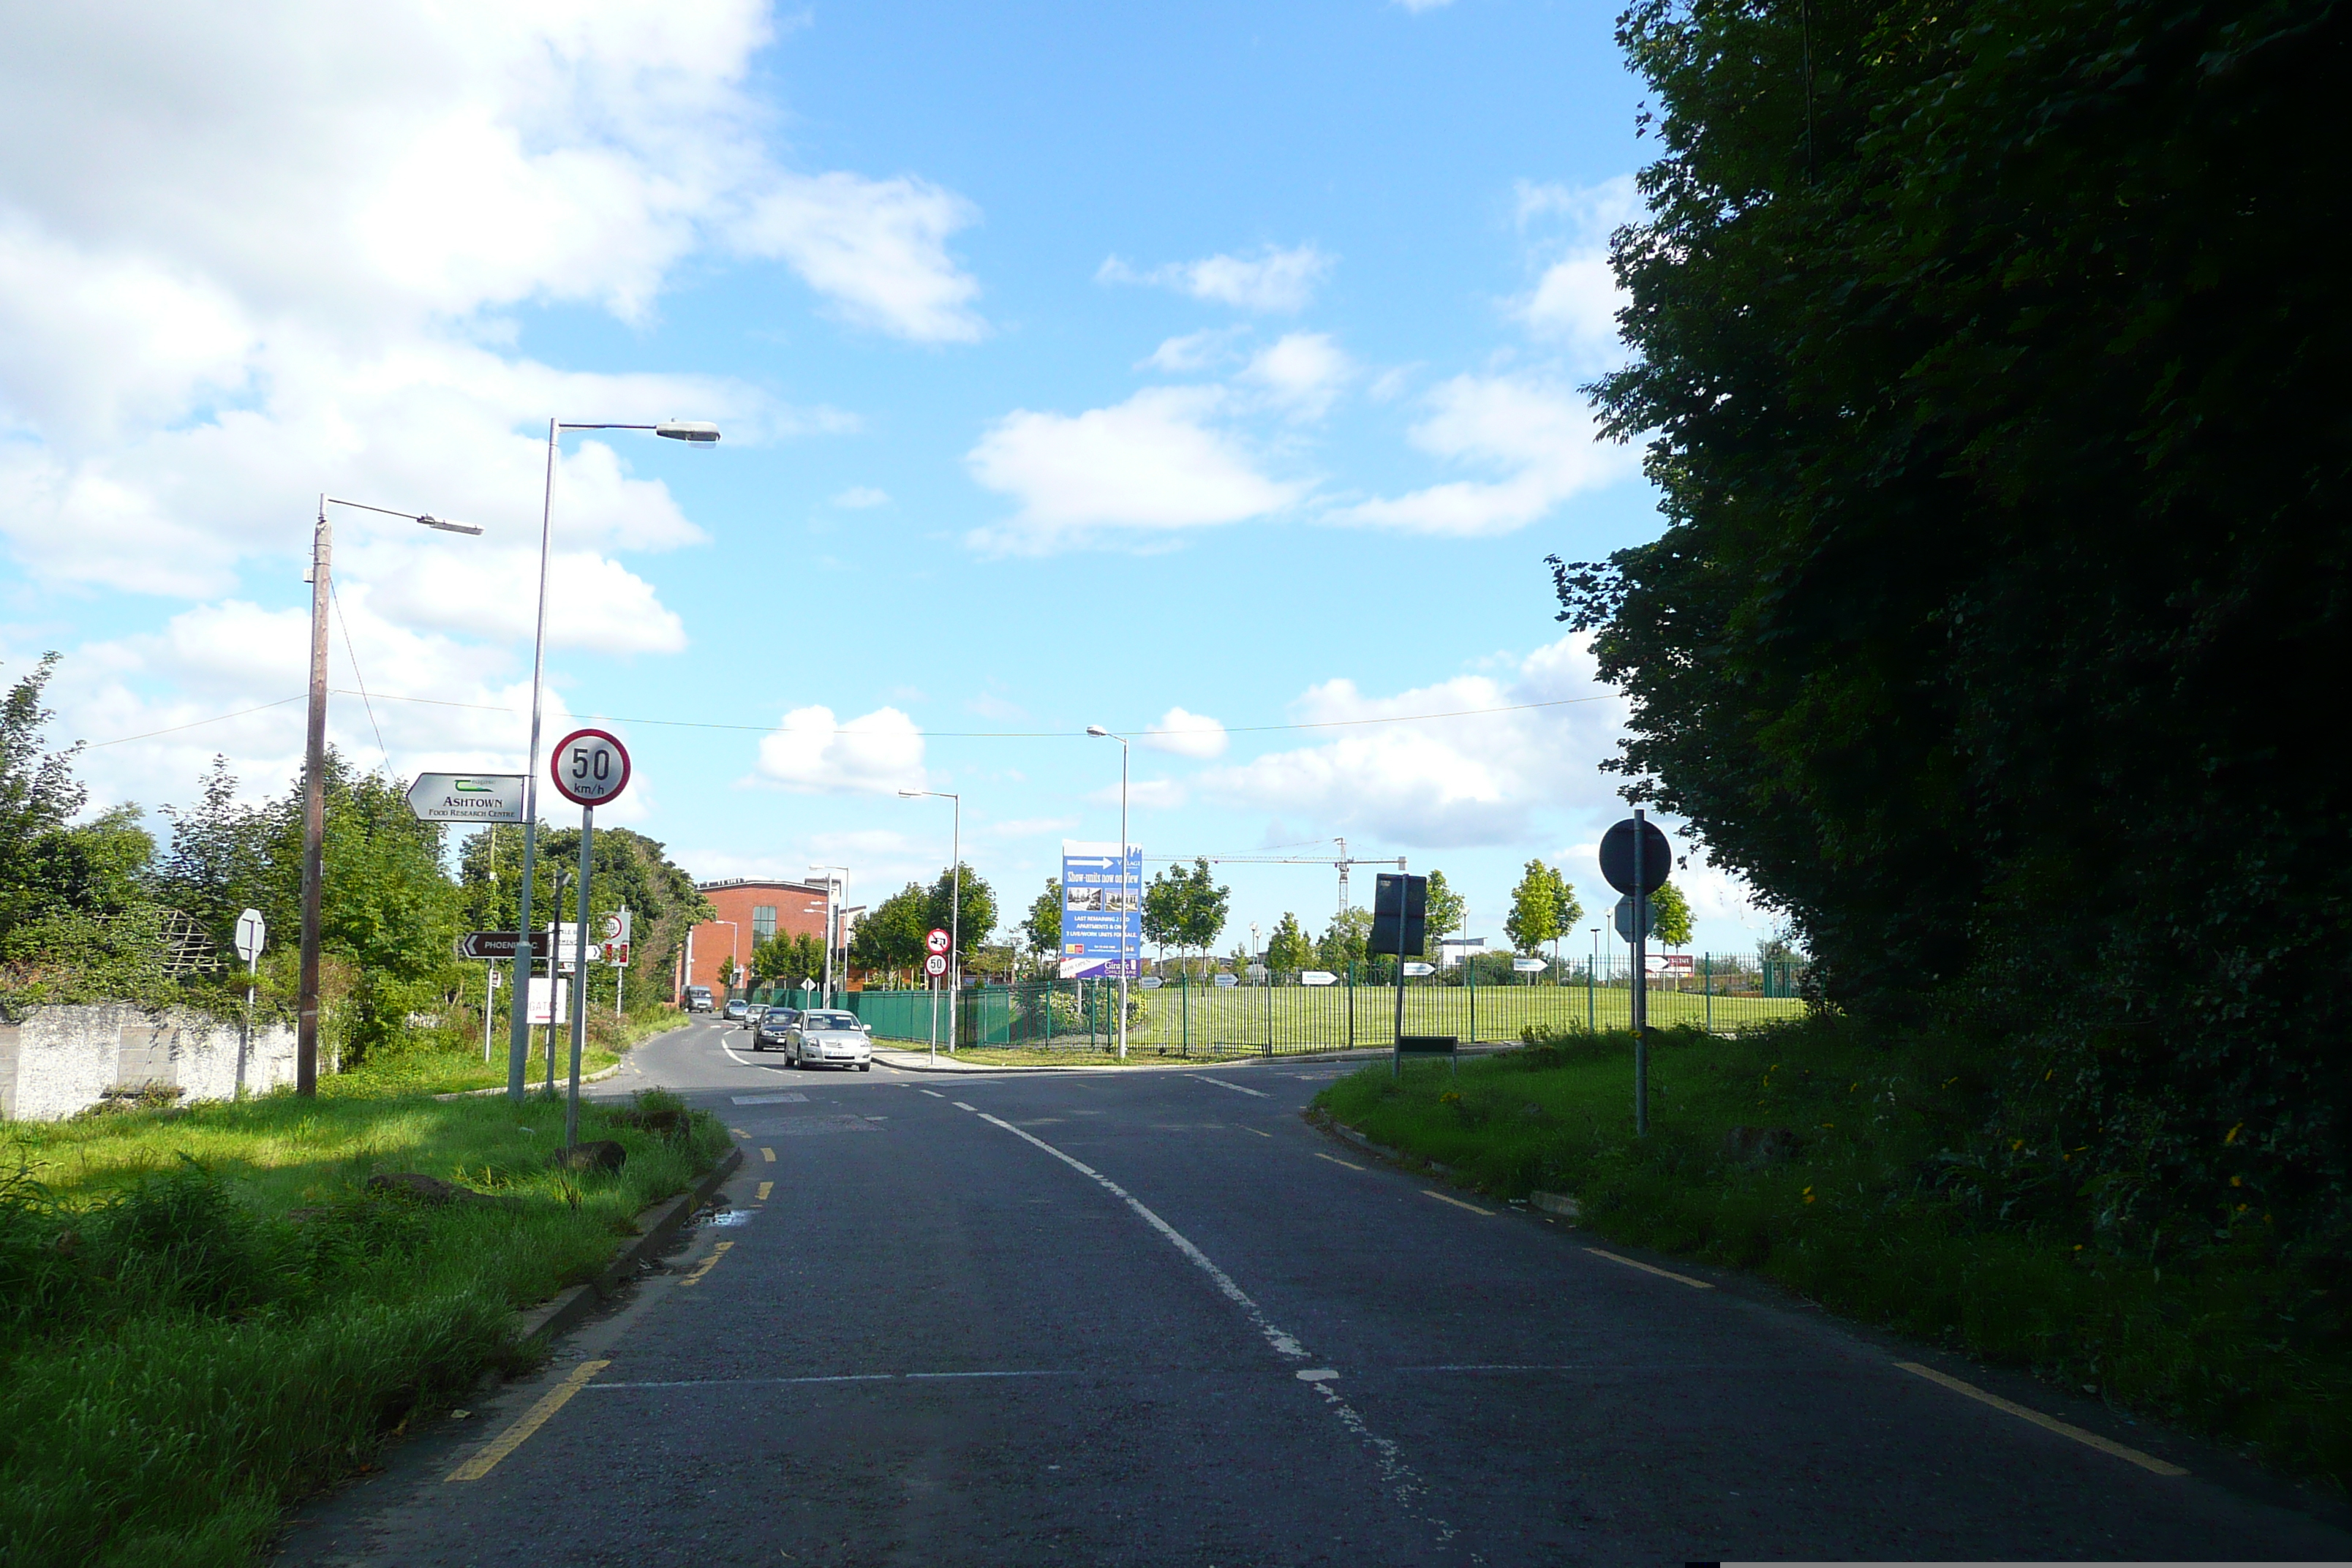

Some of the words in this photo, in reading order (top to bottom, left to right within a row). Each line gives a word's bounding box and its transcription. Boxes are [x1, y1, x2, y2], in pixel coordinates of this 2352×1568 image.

[573, 747, 610, 780] 50
[574, 783, 604, 795] km/h
[443, 796, 502, 808] ASHTOWN
[429, 808, 448, 816] FOOD
[451, 809, 486, 817] RESEARCH
[488, 810, 516, 818] CENTRE
[1101, 874, 1115, 883] now
[484, 941, 519, 949] PHOENI
[930, 959, 942, 969] 50
